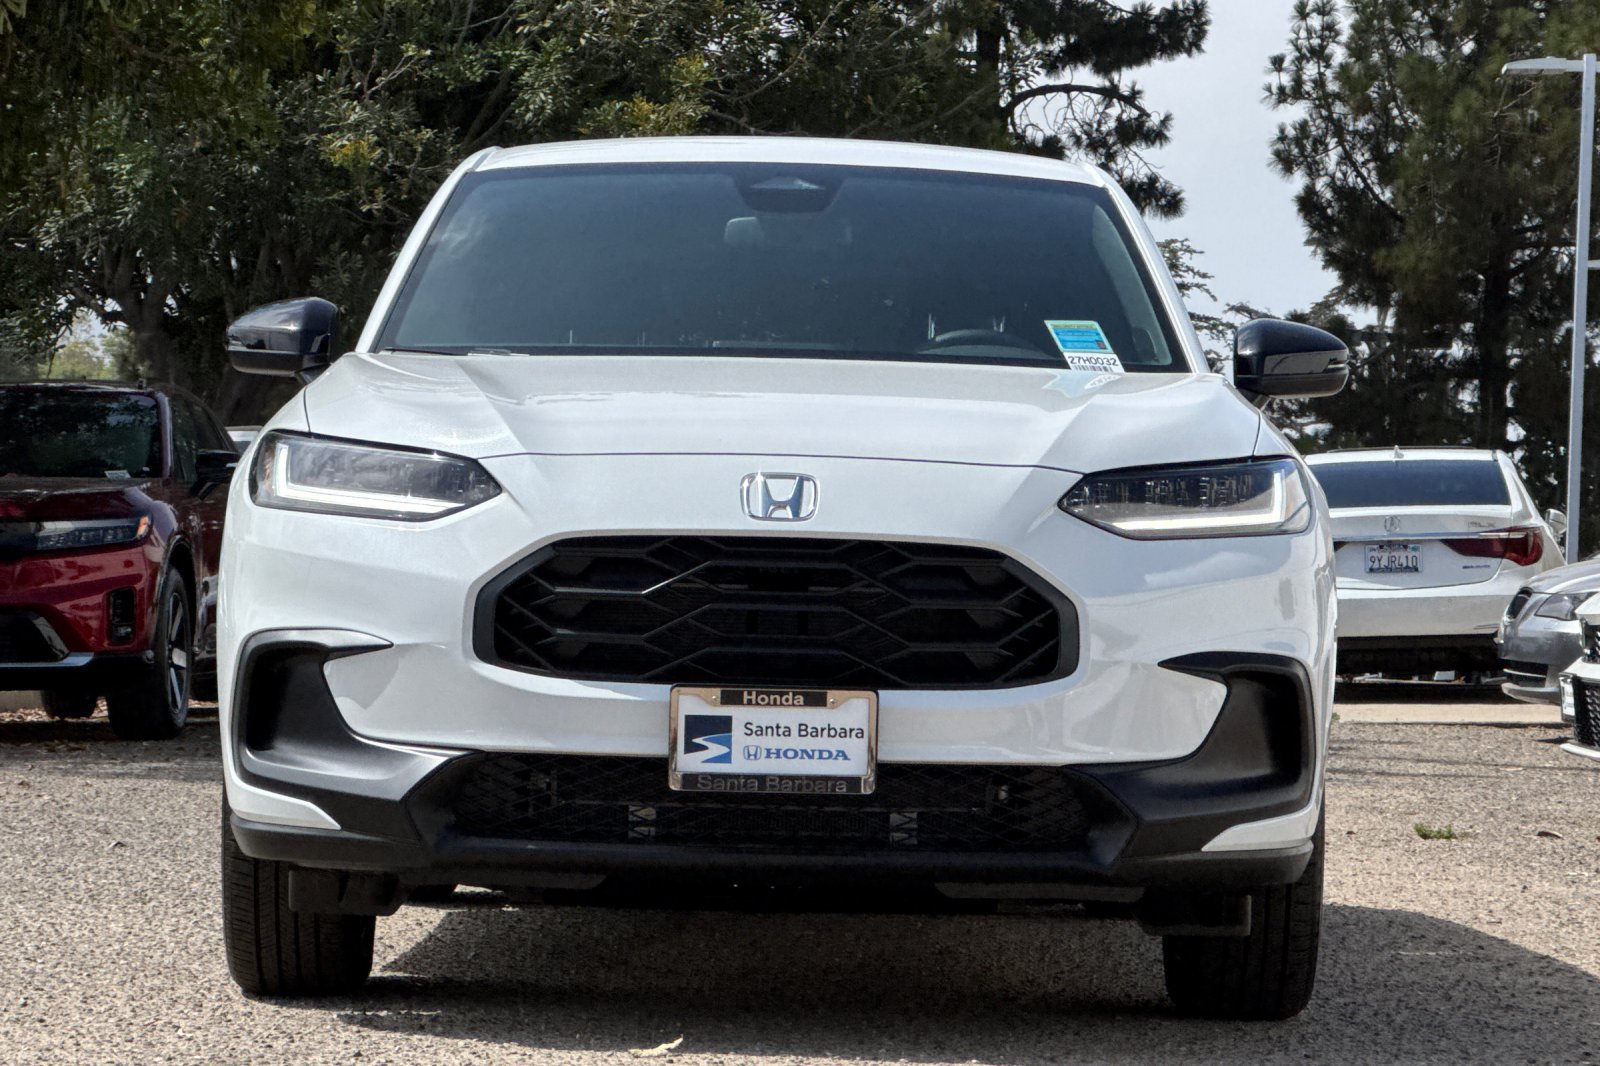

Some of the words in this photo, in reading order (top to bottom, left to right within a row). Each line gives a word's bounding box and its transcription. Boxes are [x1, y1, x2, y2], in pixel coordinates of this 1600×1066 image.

[1068, 356, 1119, 367] 27H0032
[1369, 555, 1418, 568] 9YJR410
[743, 691, 805, 706] Honda
[744, 722, 792, 737] Santa
[798, 724, 865, 739] Barbara
[765, 748, 851, 761] HONDA
[697, 775, 759, 791] Santa
[766, 776, 848, 793] Barbara
